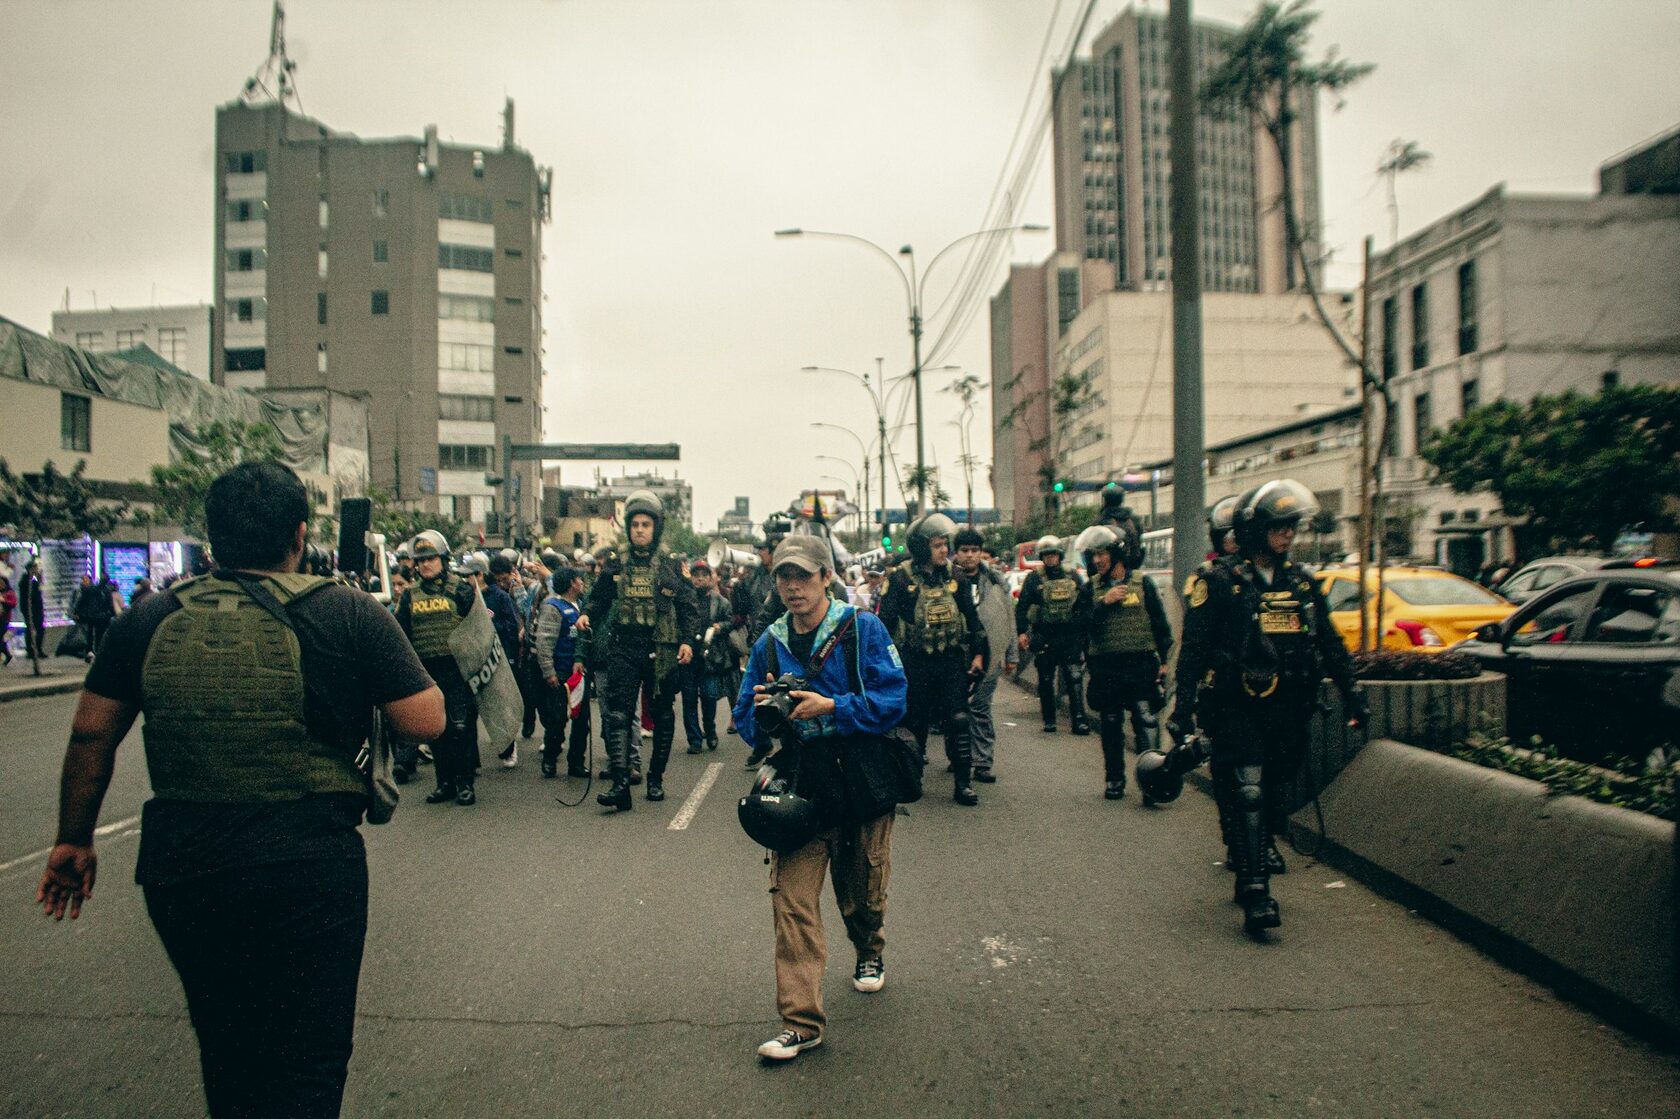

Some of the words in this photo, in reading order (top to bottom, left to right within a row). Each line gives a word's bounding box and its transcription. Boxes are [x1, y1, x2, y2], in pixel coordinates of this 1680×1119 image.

[412, 598, 451, 613] POLICIA
[819, 634, 837, 658] Canon
[468, 633, 501, 695] POLIC
